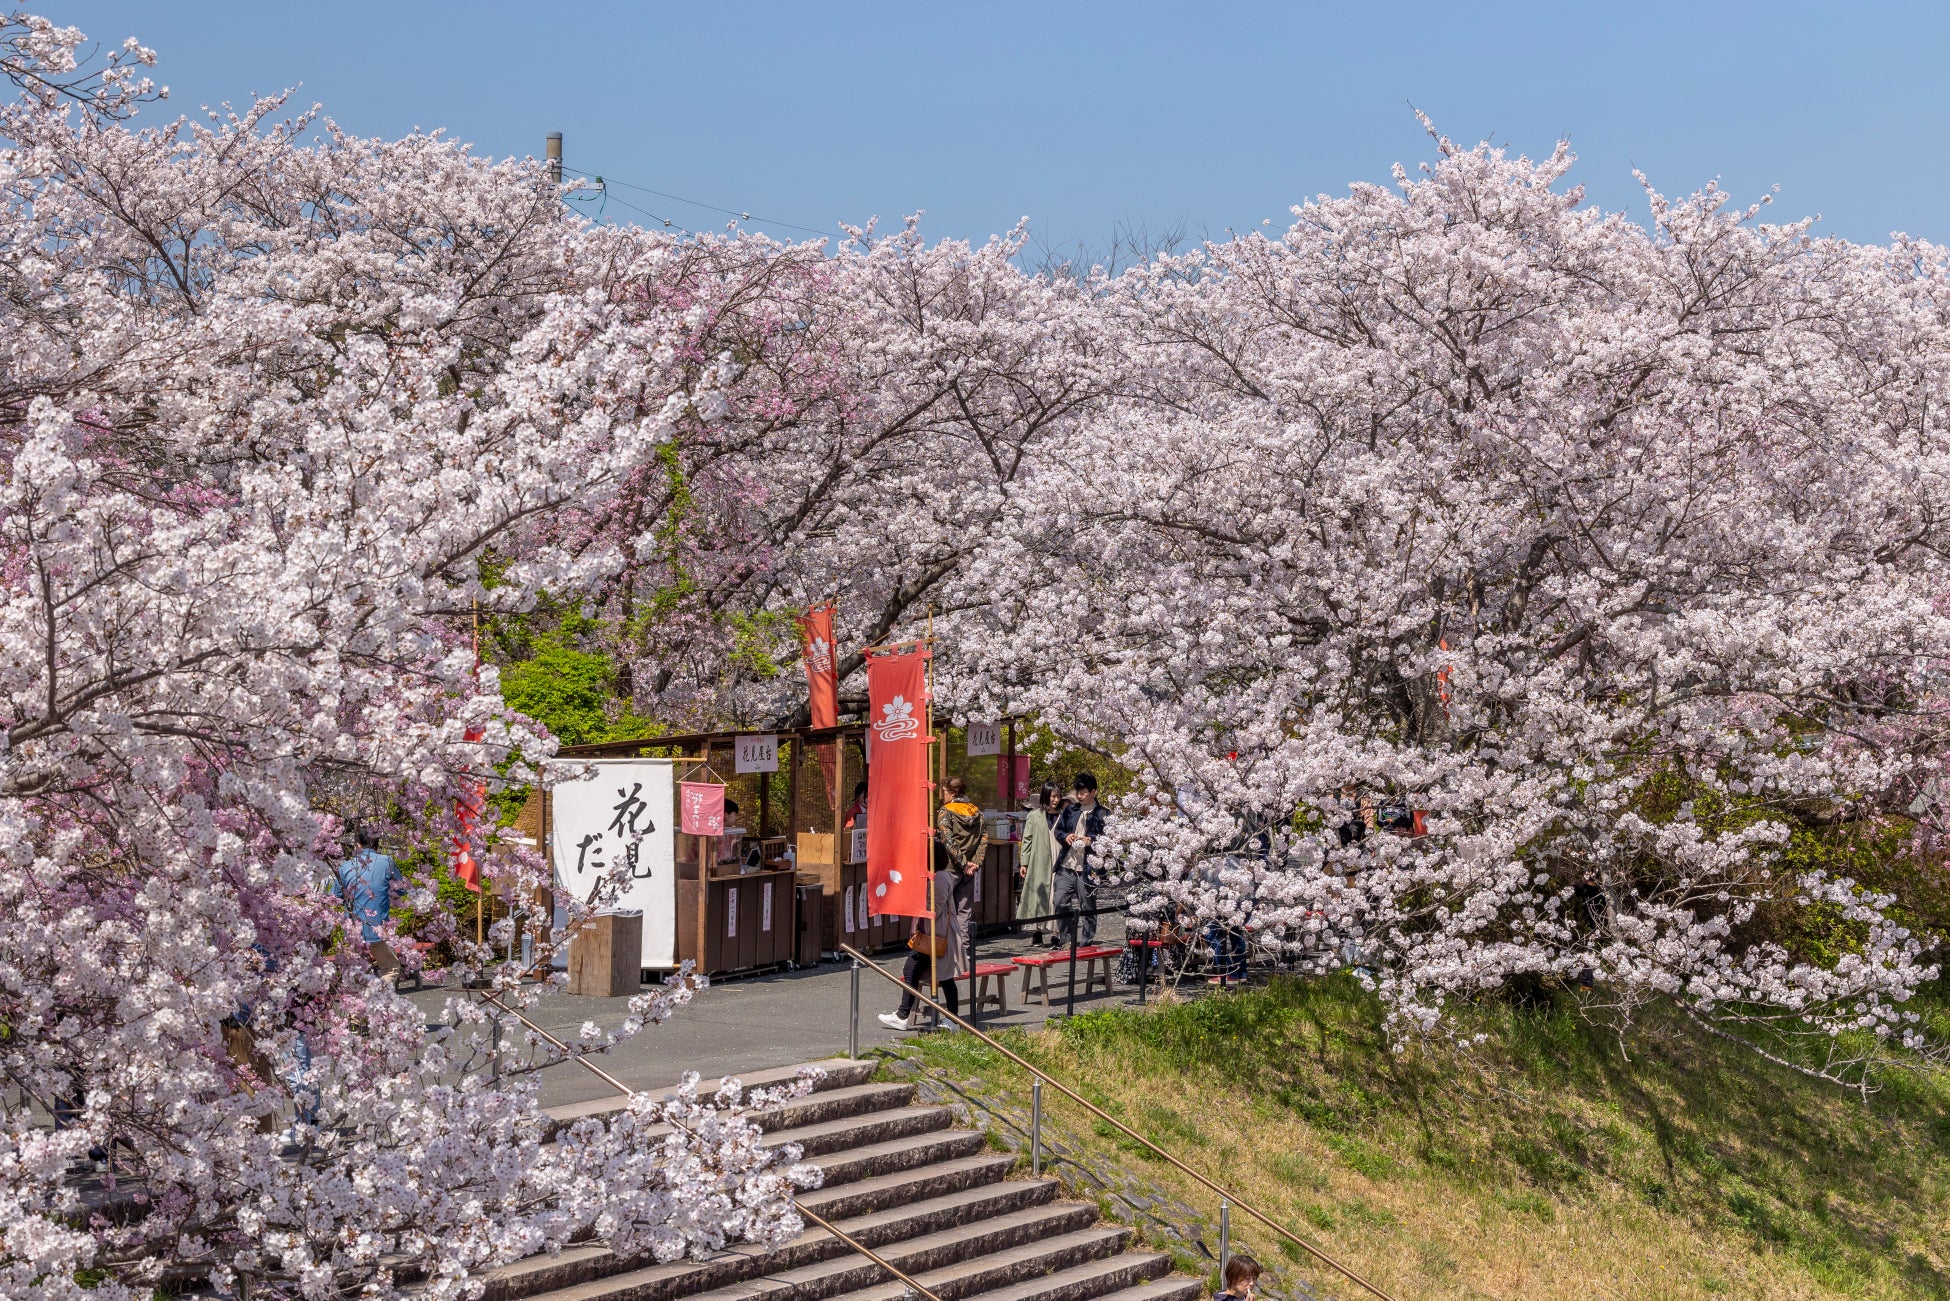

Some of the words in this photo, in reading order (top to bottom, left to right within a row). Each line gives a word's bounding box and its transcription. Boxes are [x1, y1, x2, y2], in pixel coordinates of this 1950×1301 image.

[742, 745, 772, 763] 花見屋台
[608, 782, 655, 878] 花見
